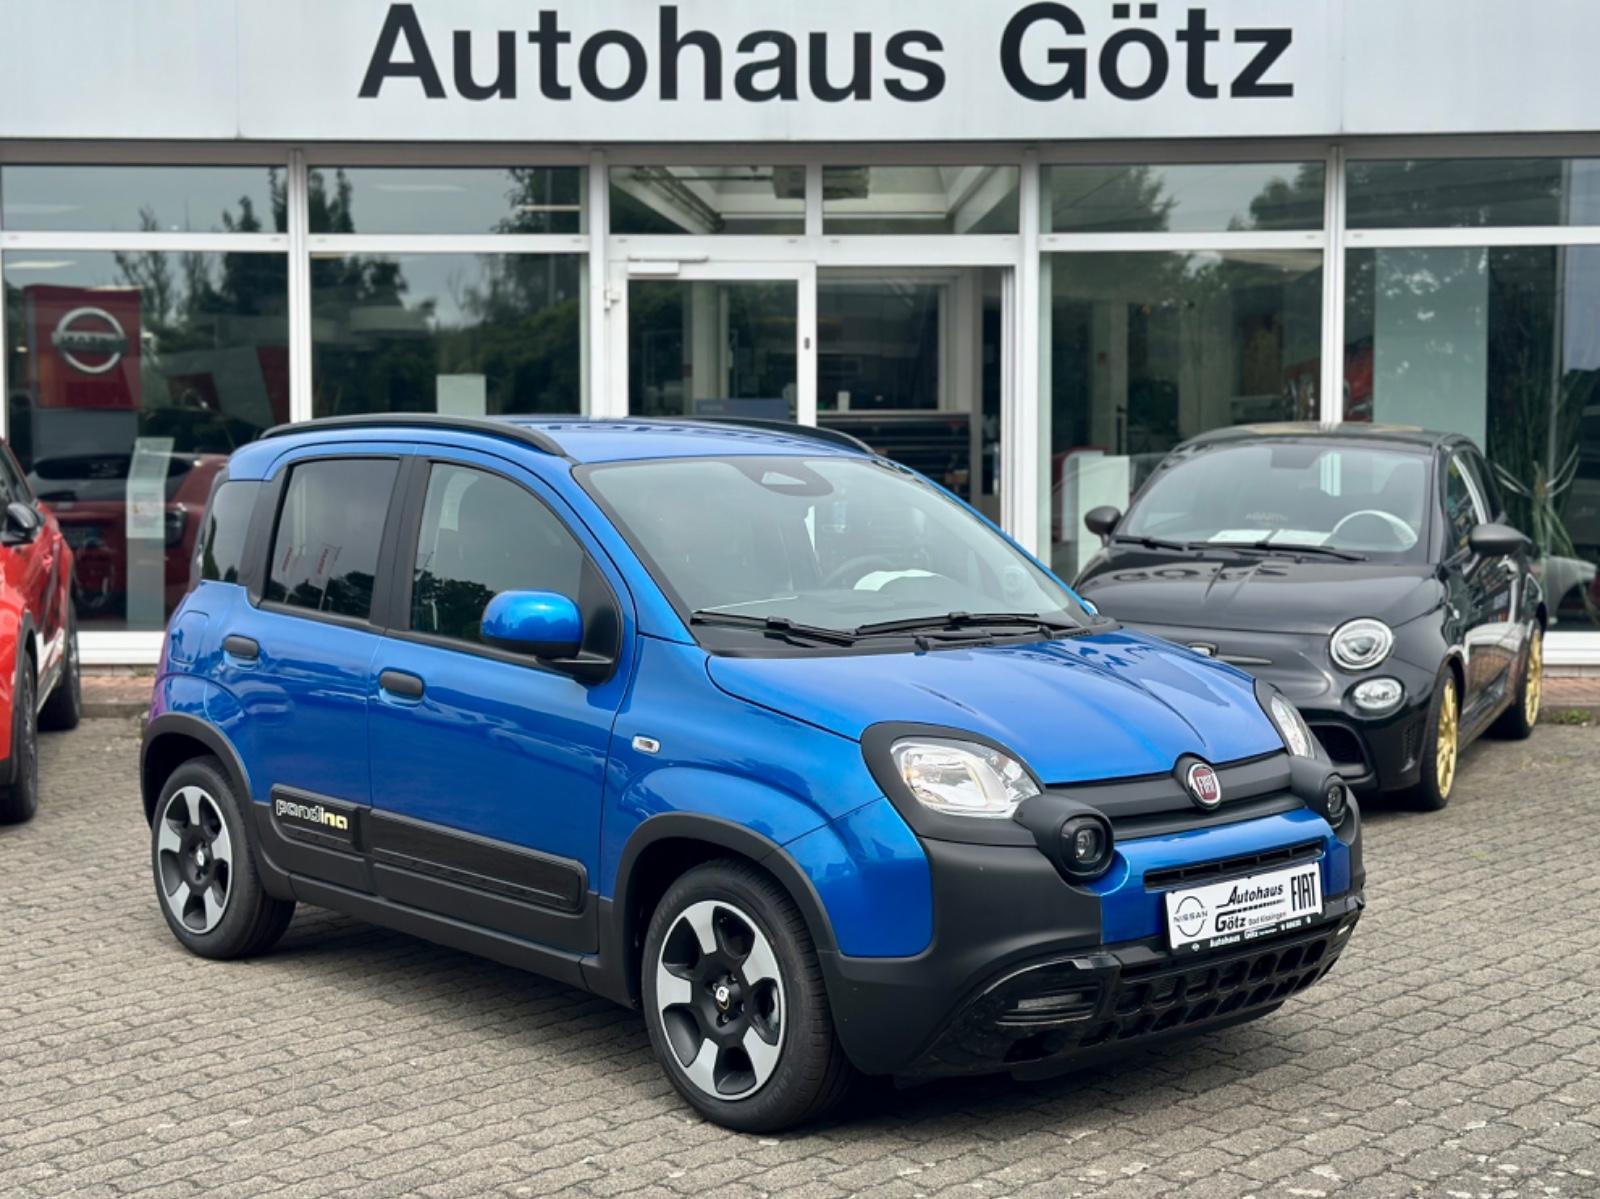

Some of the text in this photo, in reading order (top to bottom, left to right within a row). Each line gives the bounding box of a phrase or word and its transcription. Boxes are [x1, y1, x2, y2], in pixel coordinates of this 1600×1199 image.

[357, 1, 1294, 102] Autohaus Götz
[275, 799, 348, 830] pandina
[1216, 884, 1284, 908] Autohaus
[1290, 872, 1316, 912] FIAT
[1173, 910, 1208, 922] NISSAN
[1215, 909, 1246, 932] Götz
